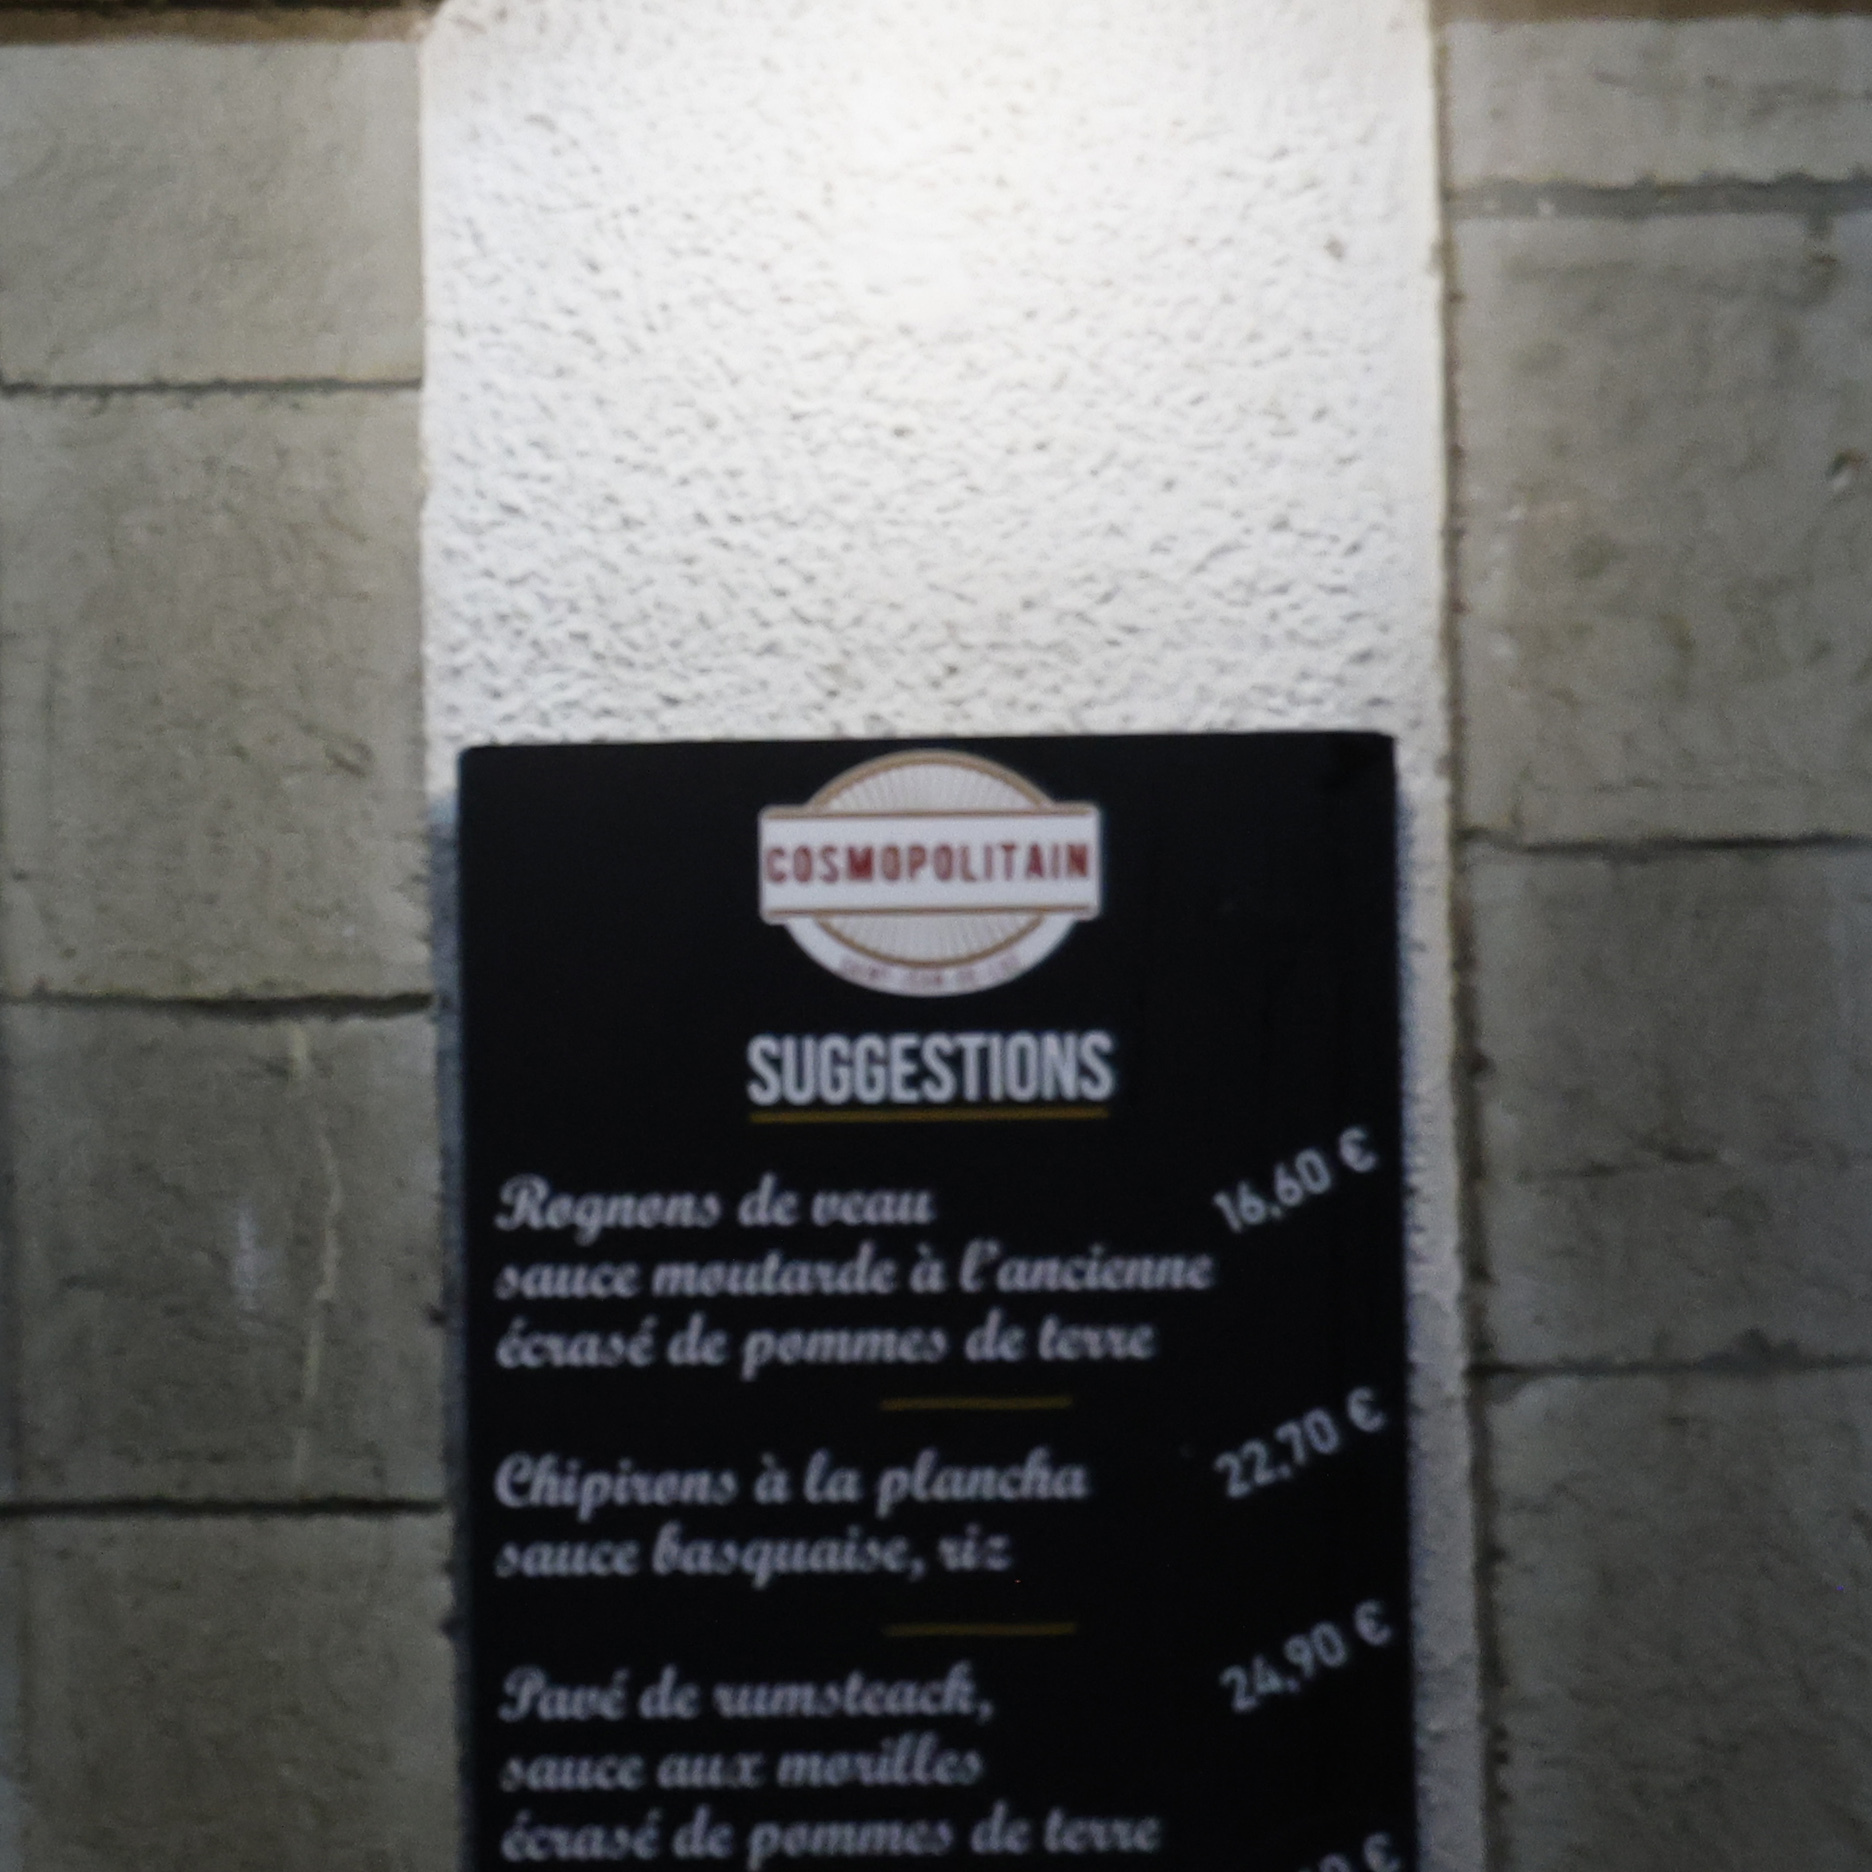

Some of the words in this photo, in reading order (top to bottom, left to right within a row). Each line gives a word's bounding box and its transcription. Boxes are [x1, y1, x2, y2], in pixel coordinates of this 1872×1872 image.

[765, 843, 1090, 884] COSMOPOLITAIN
[746, 1030, 1114, 1106] SUGGESTIONS
[1339, 1127, 1376, 1172] €
[495, 1176, 721, 1245] Rognons
[738, 1173, 798, 1226] de
[811, 1191, 933, 1226] veau
[496, 1264, 639, 1299] sauce
[652, 1241, 896, 1296] moutarde
[909, 1244, 946, 1293] à
[959, 1240, 1212, 1292] l'ancienne
[496, 1317, 656, 1368] écrasé
[667, 1312, 727, 1365] de
[742, 1329, 947, 1380] pommes
[964, 1308, 1025, 1361] de
[1038, 1316, 1153, 1360] terre
[1347, 1388, 1385, 1432] €
[494, 1454, 737, 1522] Chipirons
[754, 1454, 790, 1504] à
[803, 1451, 861, 1503] la
[876, 1447, 1088, 1518] plancha
[496, 1542, 638, 1577] sauce
[652, 1522, 925, 1589] basquaise,
[938, 1524, 1010, 1571] riz
[1354, 1601, 1391, 1645] €
[499, 1668, 627, 1721] Pavé
[638, 1665, 698, 1719] de
[713, 1662, 993, 1720] rumsteack,
[502, 1756, 643, 1791] sauce
[657, 1754, 762, 1788] aux
[776, 1732, 983, 1786] morilles
[501, 1809, 660, 1861] écrasé
[672, 1805, 732, 1858] de
[747, 1821, 954, 1872] pommes
[970, 1801, 1030, 1854] de
[1043, 1808, 1159, 1853] terre
